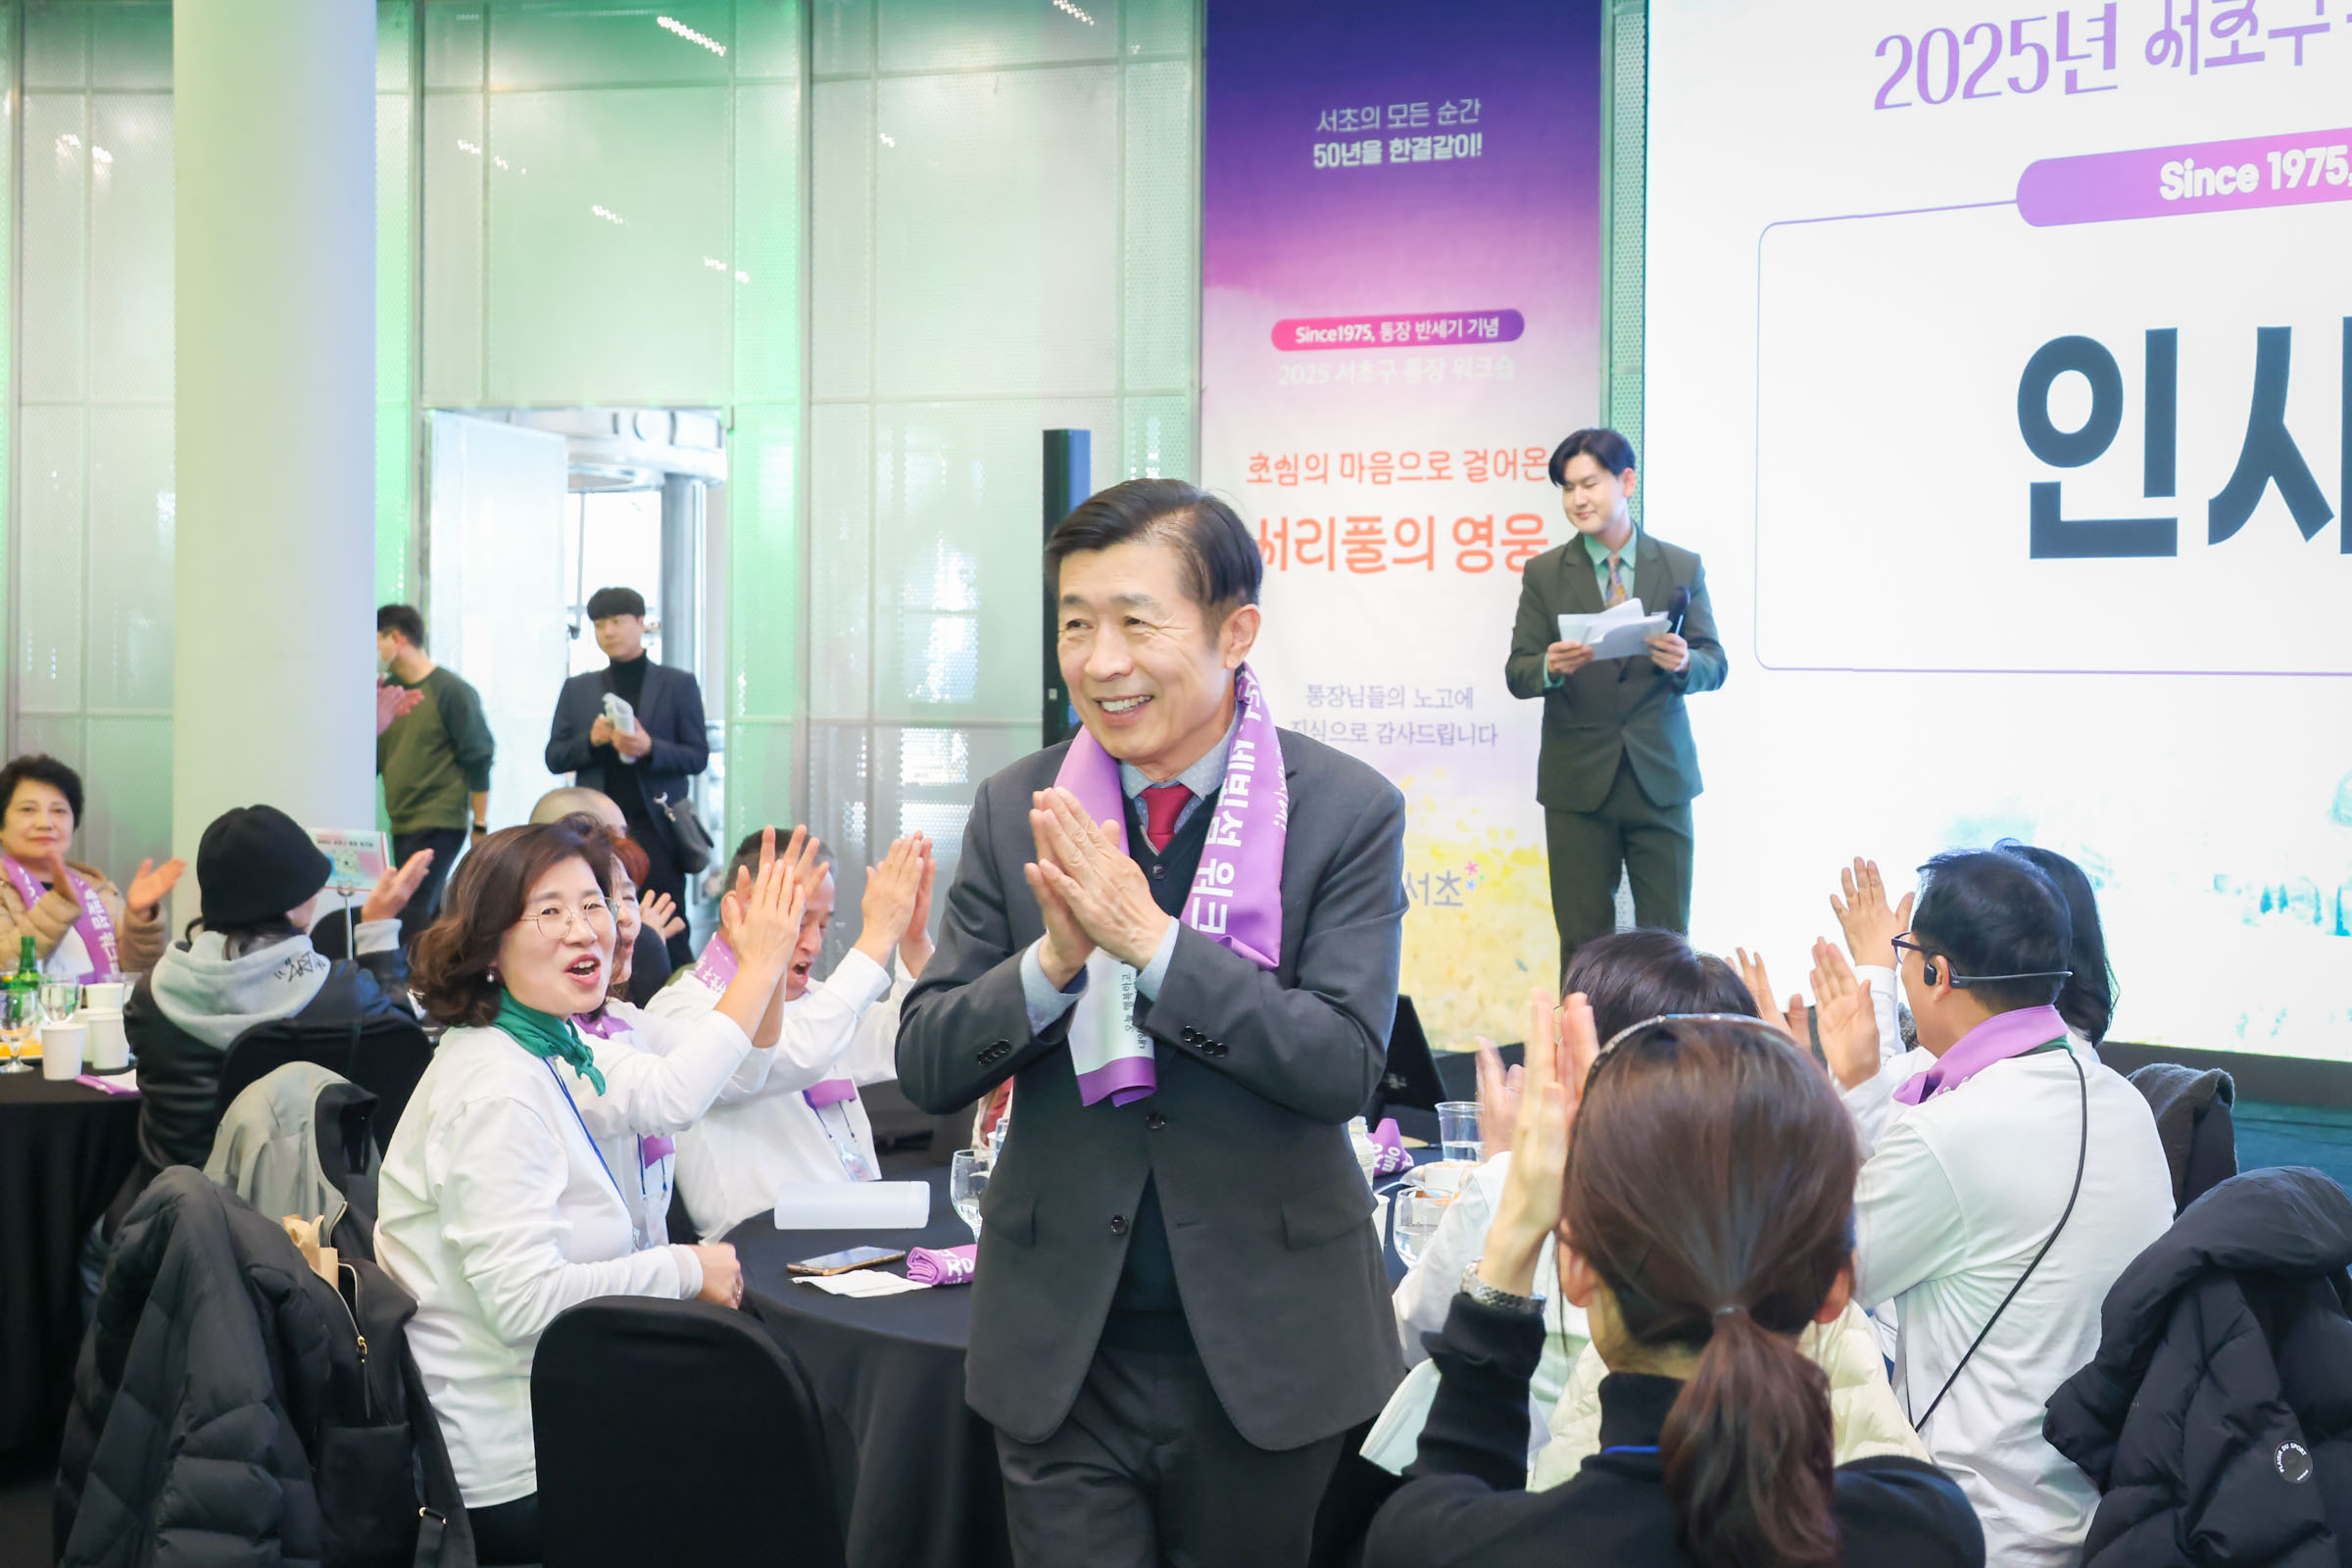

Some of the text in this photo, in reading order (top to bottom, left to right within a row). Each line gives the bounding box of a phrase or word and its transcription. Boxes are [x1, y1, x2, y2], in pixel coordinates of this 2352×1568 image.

[1873, 2, 2118, 110] 2025년
[1316, 98, 1482, 133] 서초의 모든 순간
[1313, 132, 1483, 169] 50년을 한결같이!
[2159, 144, 2352, 201] Since 1975,
[1295, 317, 1499, 344] Since1975, 통장 반세기 기념
[1278, 364, 1330, 386] 2025
[1335, 359, 1396, 385] 서초구
[1402, 357, 1446, 384] 통장
[1247, 447, 1549, 486] 초심의 마음으로 걸어온
[1257, 513, 1548, 574] 서리풀의 영웅
[1306, 684, 1474, 710] 통장님들의 노고에
[1376, 721, 1498, 747] 감사드립니다
[1405, 870, 1464, 906] 서초
